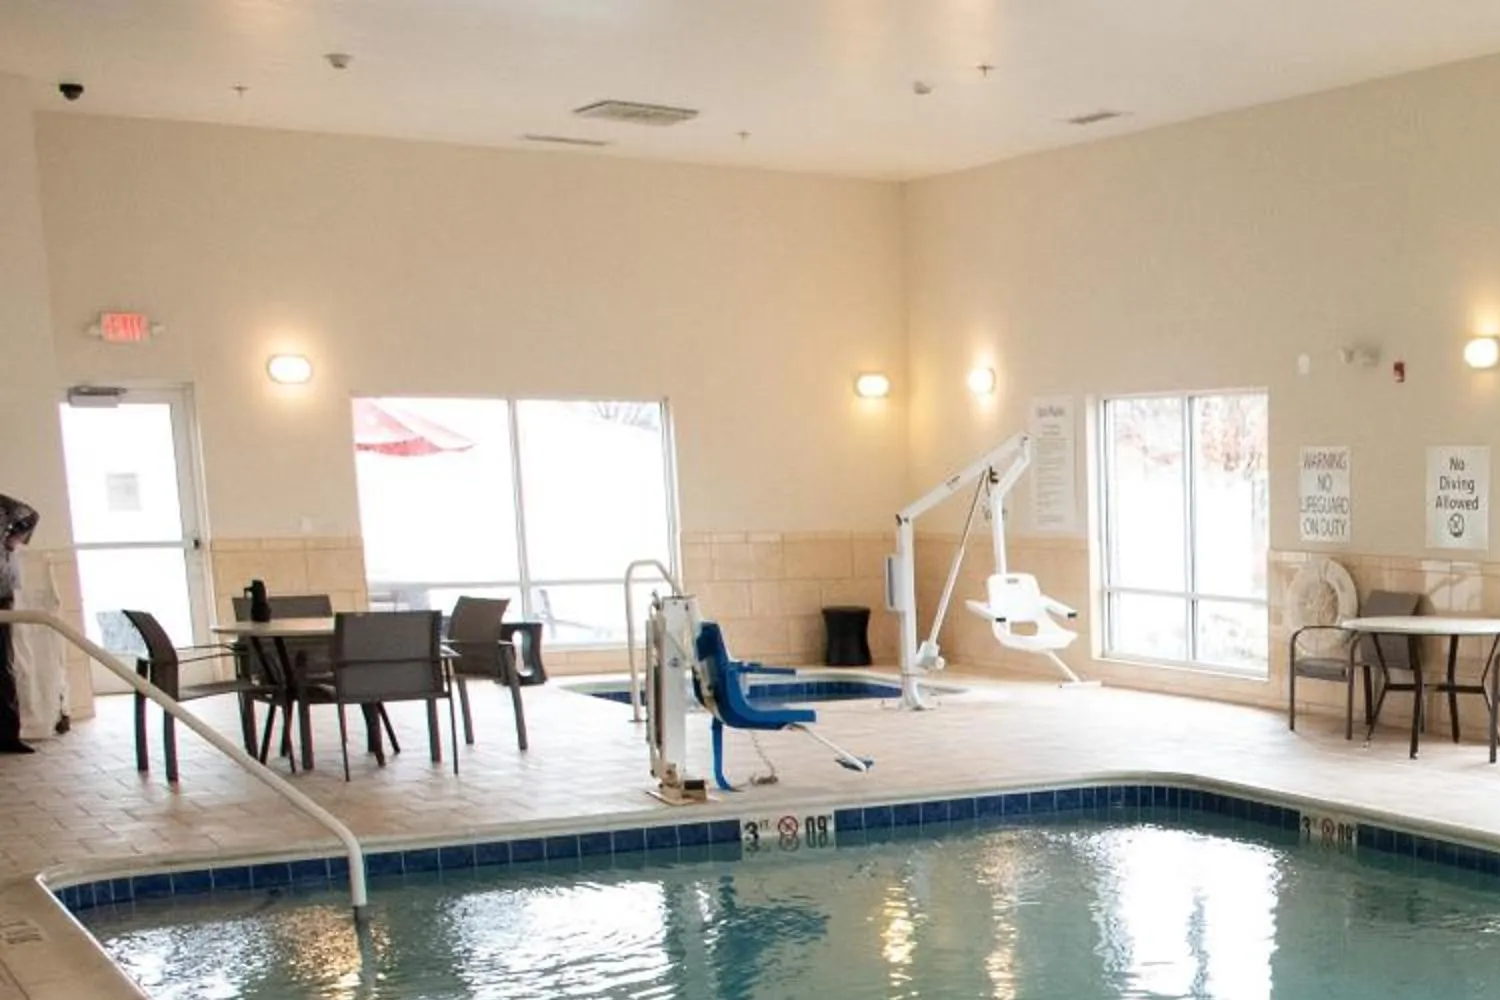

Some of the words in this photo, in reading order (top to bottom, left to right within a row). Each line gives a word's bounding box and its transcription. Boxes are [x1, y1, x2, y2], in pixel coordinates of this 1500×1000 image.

[1449, 457, 1465, 471] No
[1317, 473, 1333, 493] NO
[1439, 475, 1475, 494] Diving
[1435, 495, 1479, 510] Allowed
[1303, 518, 1319, 536] ON
[1321, 518, 1347, 536] DUTY
